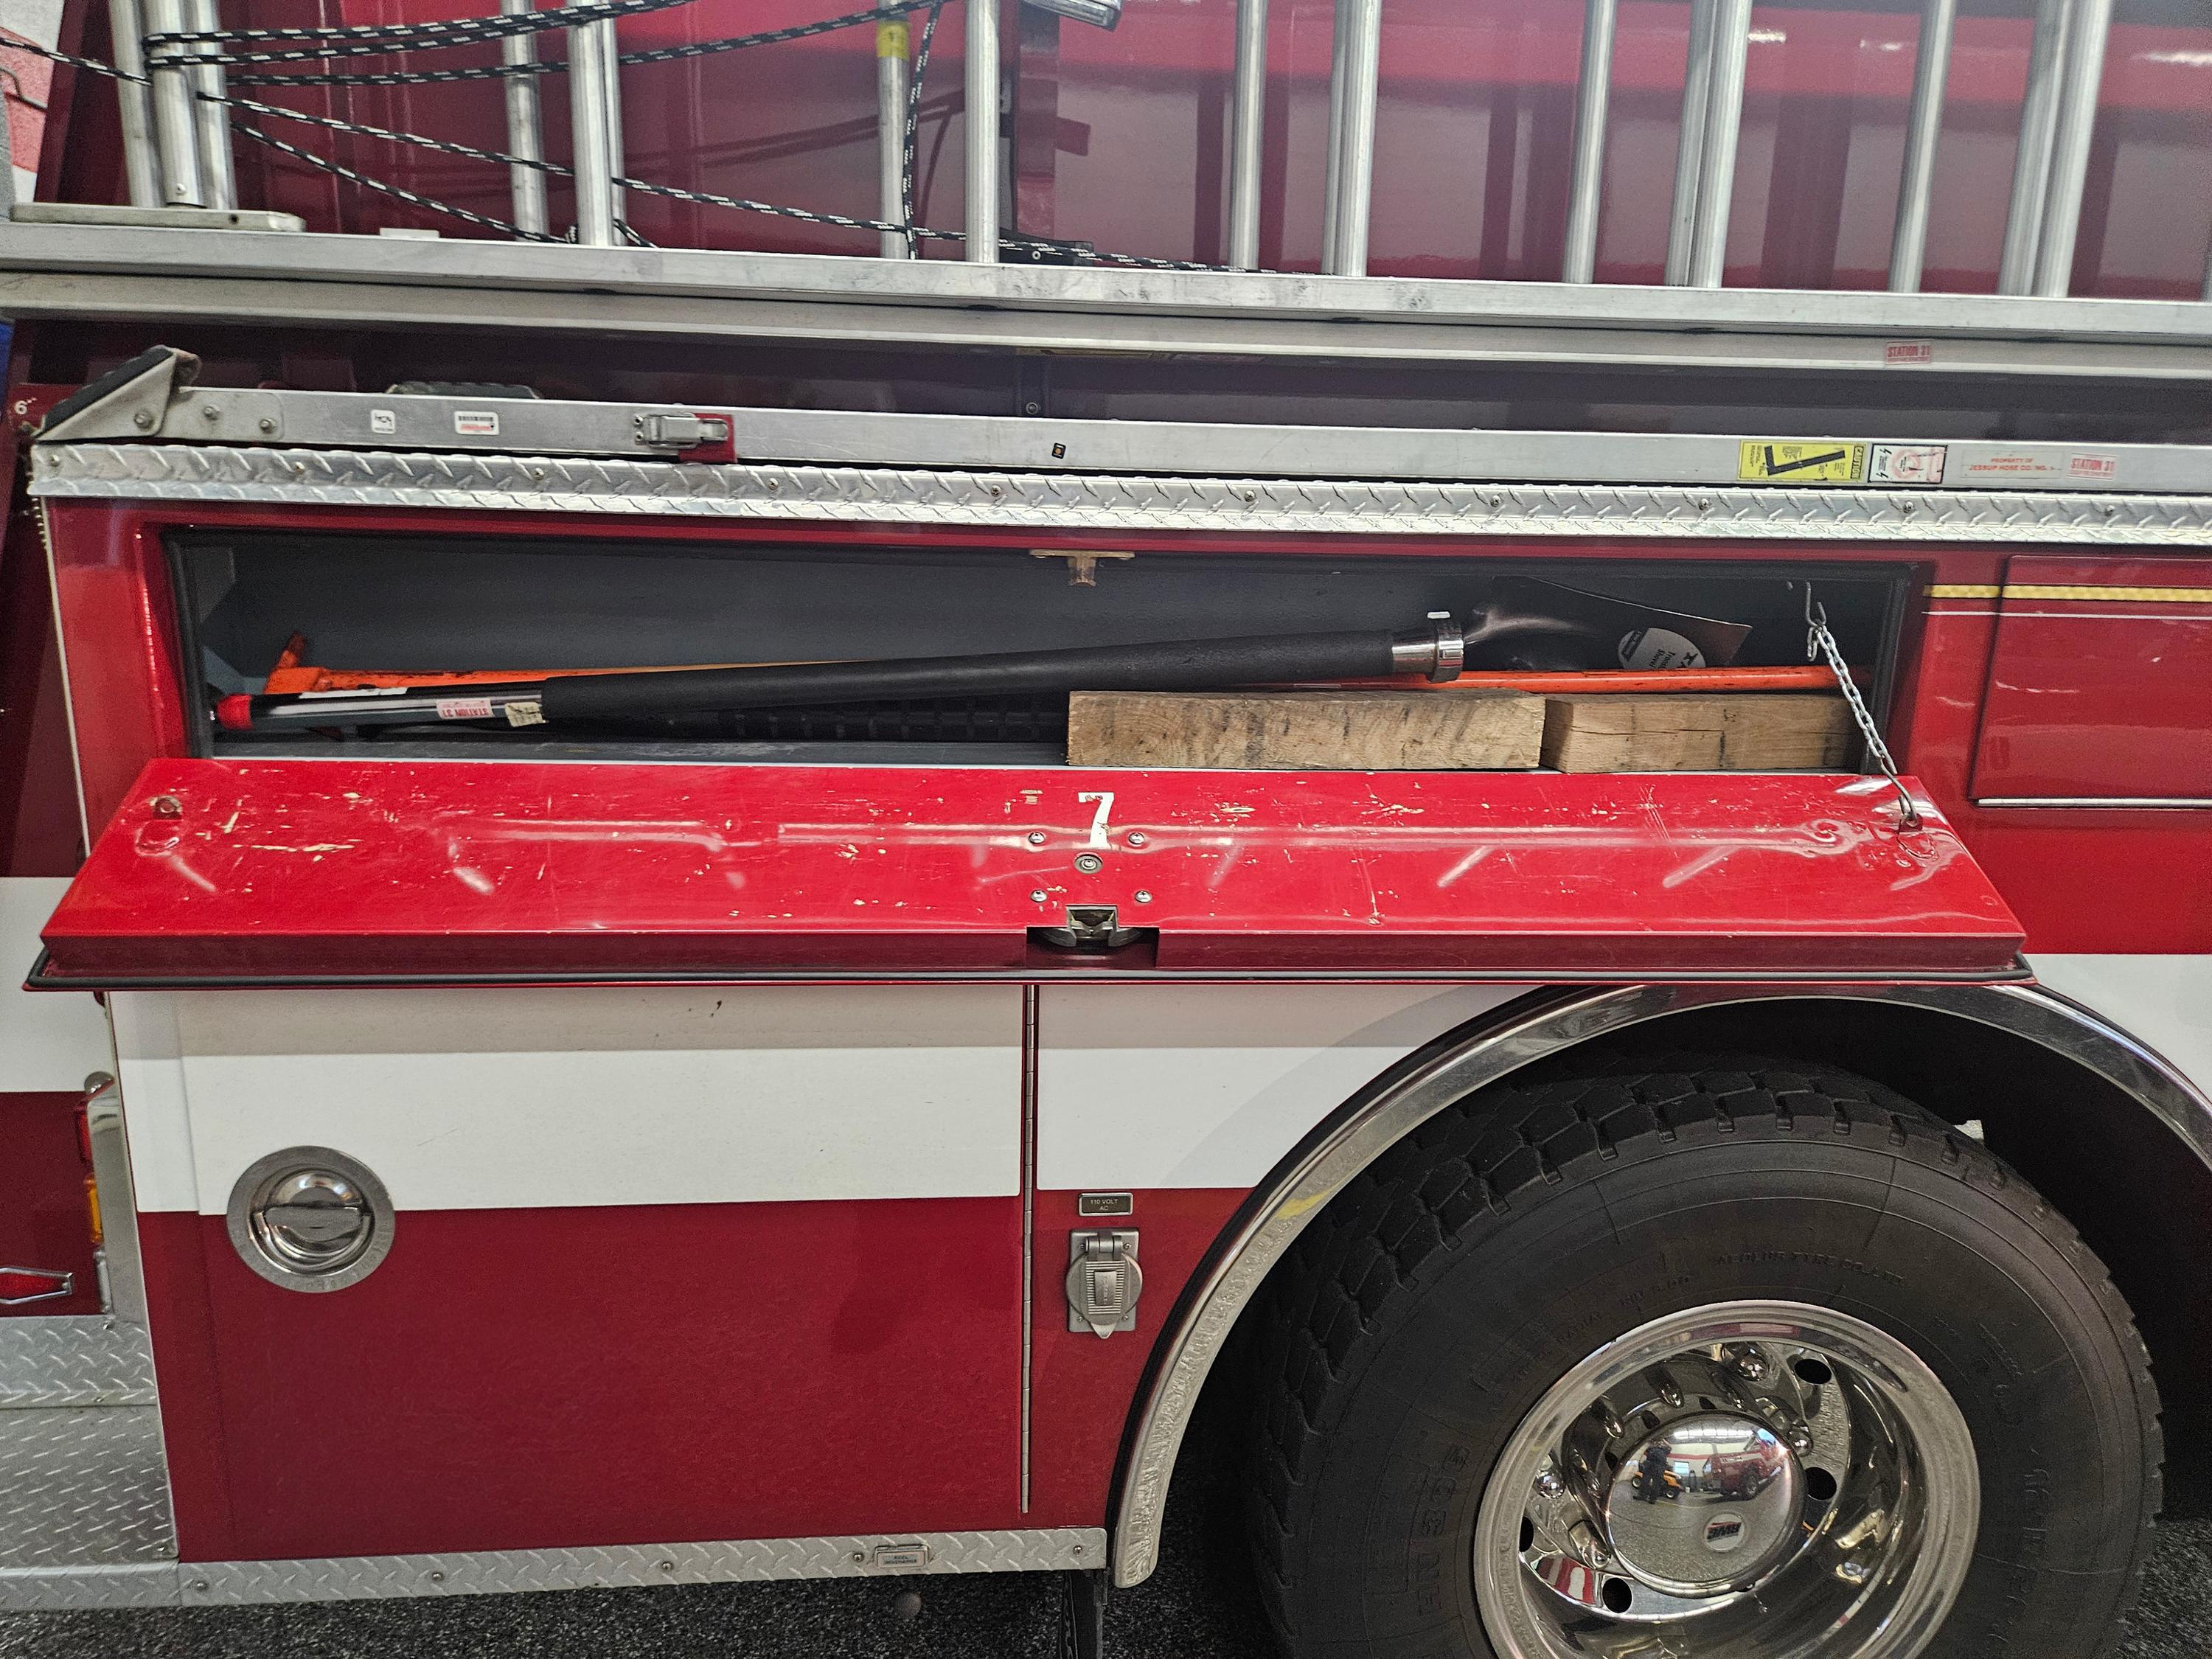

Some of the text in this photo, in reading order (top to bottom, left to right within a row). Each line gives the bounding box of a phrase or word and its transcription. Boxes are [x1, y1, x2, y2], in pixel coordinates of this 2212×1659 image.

[1887, 345, 1919, 358] STATION
[1851, 445, 1864, 479] CAUTION
[2070, 458, 2102, 470] STATION
[456, 708, 490, 717] STATION
[1077, 792, 1115, 847] 7
